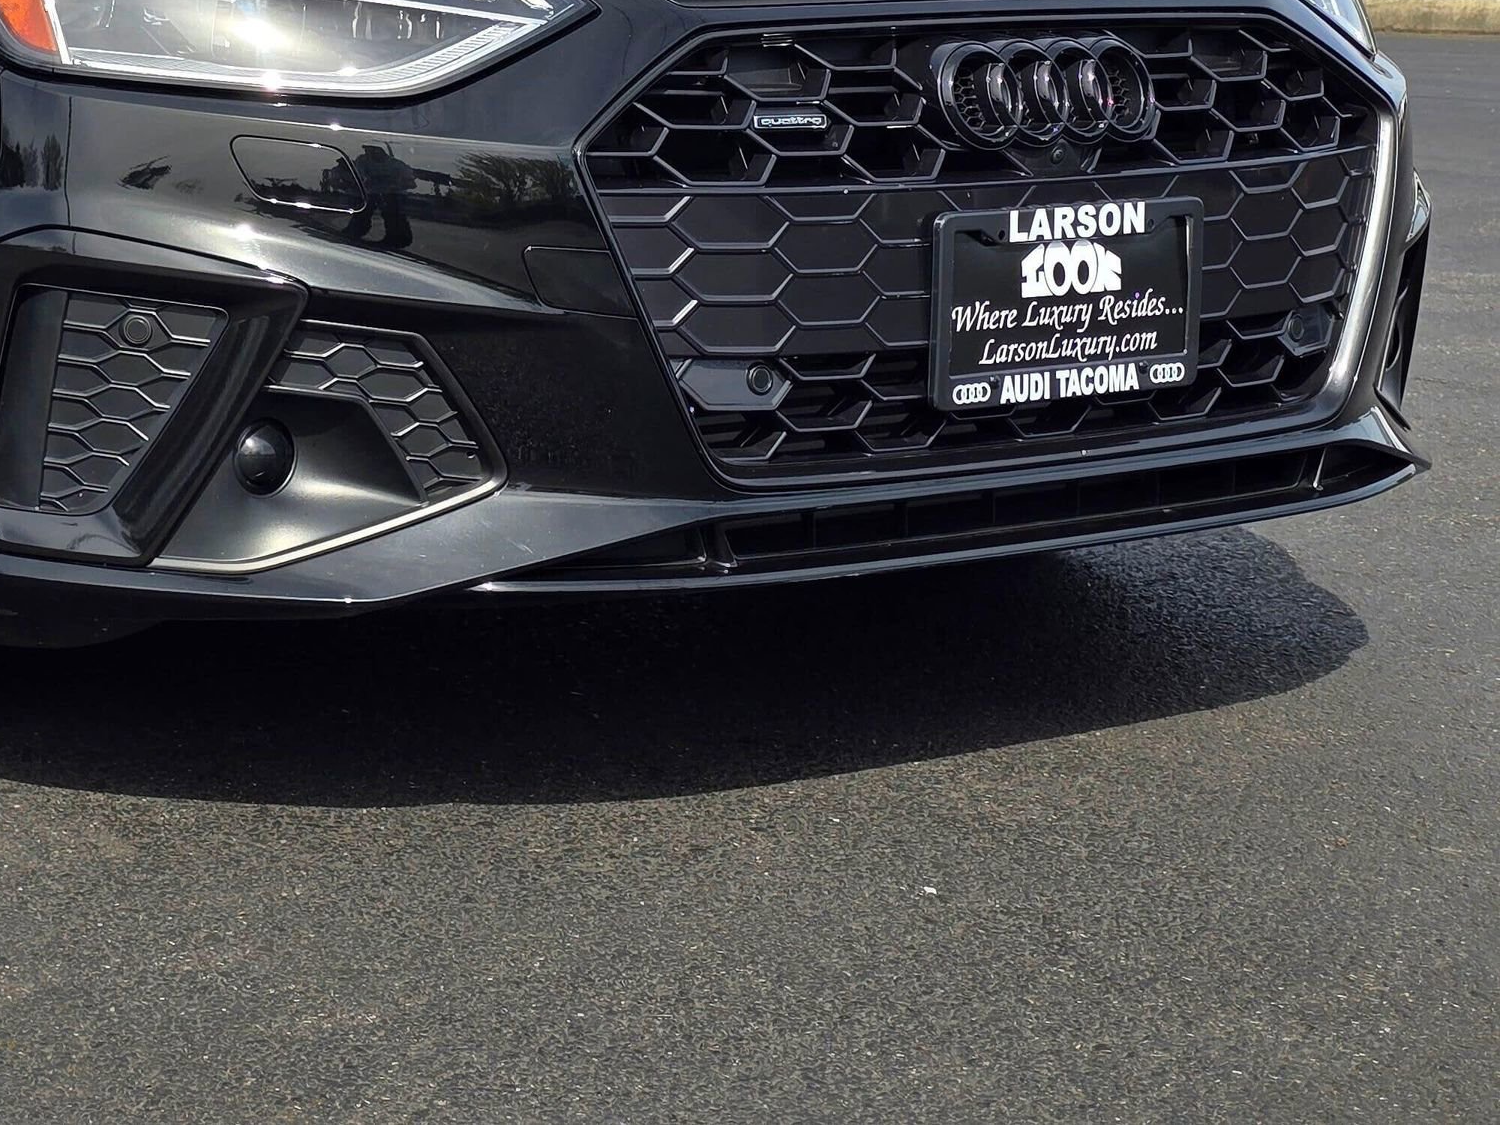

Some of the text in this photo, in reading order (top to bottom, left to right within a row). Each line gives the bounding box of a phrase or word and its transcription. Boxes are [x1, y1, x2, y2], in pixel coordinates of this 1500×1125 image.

[760, 116, 822, 127] quattro
[1009, 201, 1146, 243] LARSON
[951, 288, 1184, 333] Where Luxury Resides...
[978, 329, 1158, 365] LarsonLuxury.com
[1000, 361, 1140, 404] AUDI TACOMA
